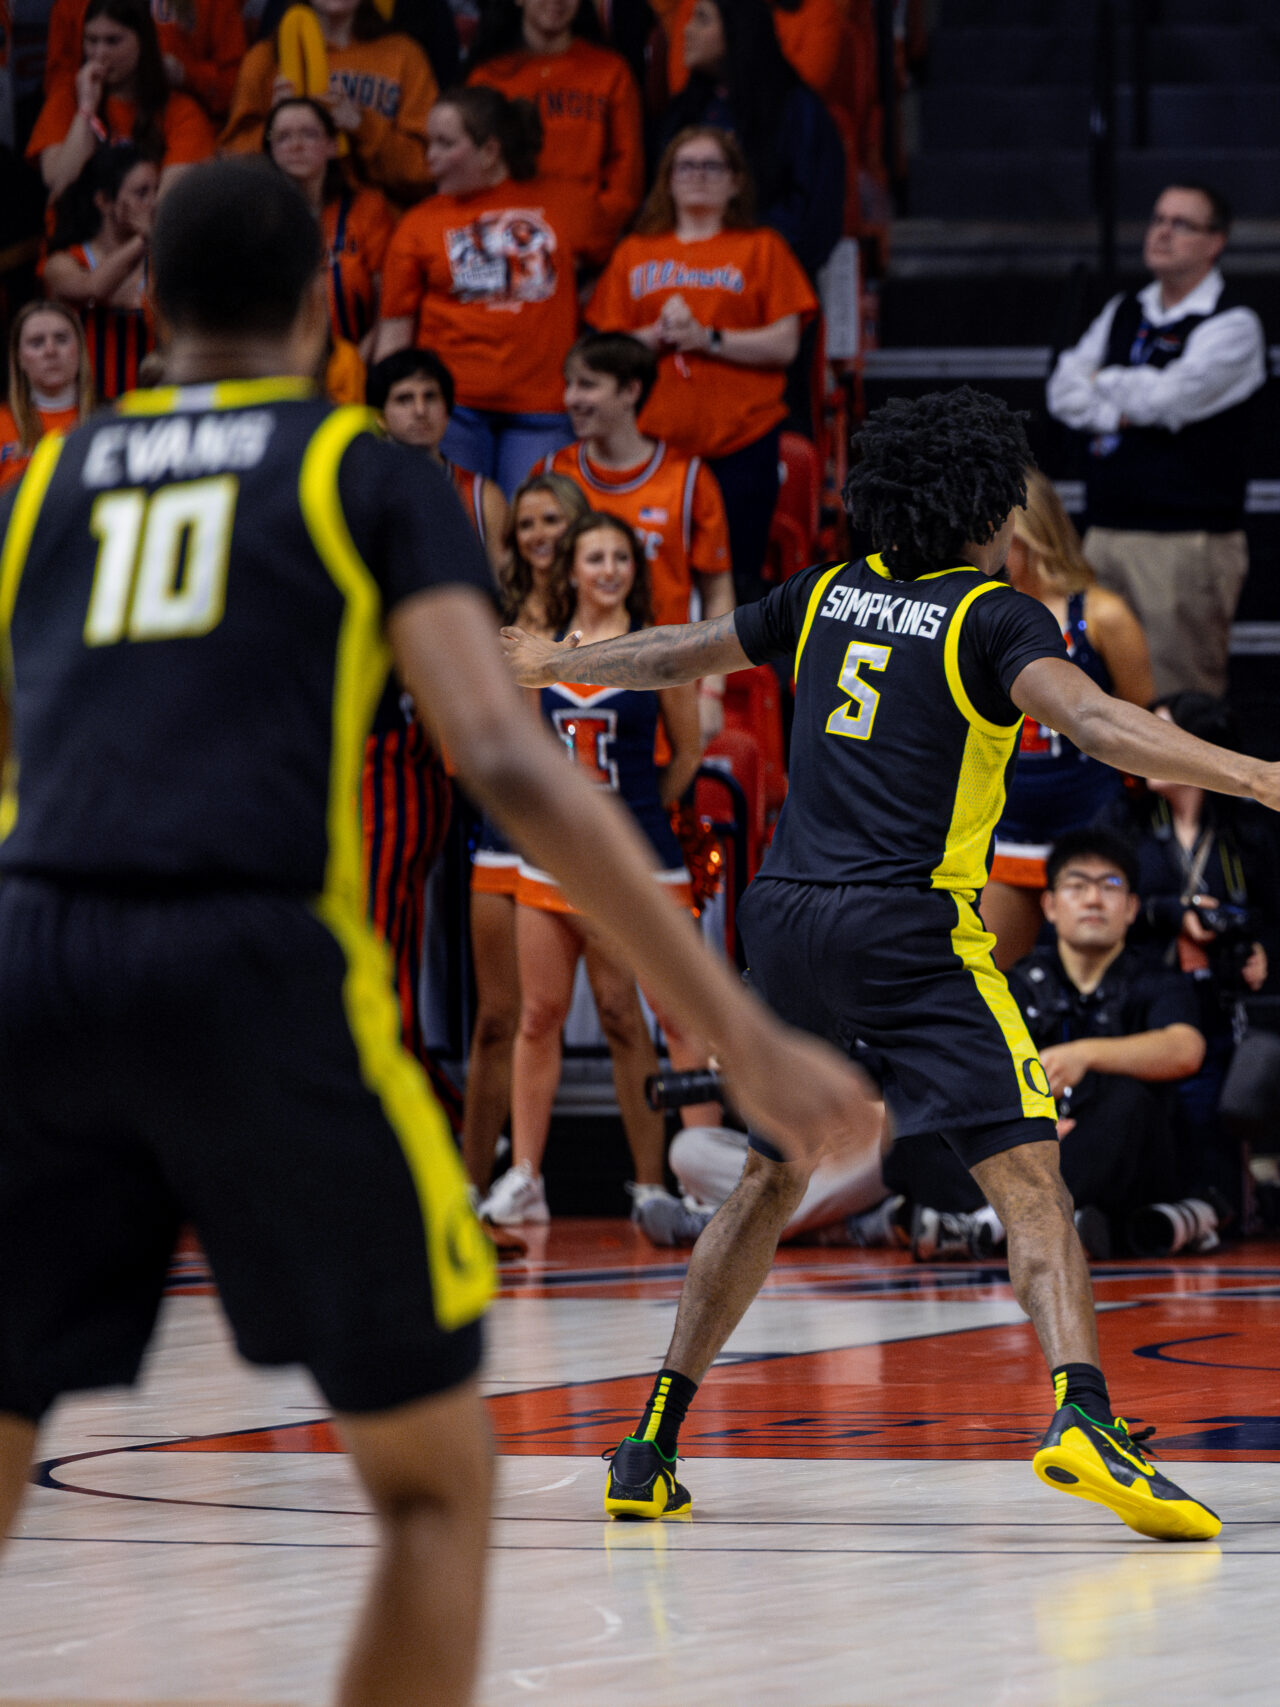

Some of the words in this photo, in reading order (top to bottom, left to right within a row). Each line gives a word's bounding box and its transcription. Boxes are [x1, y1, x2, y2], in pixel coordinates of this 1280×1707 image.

[83, 411, 276, 488] EVANS
[83, 472, 240, 648] 10
[820, 584, 948, 640] SIMPKINS
[825, 640, 893, 741] 5
